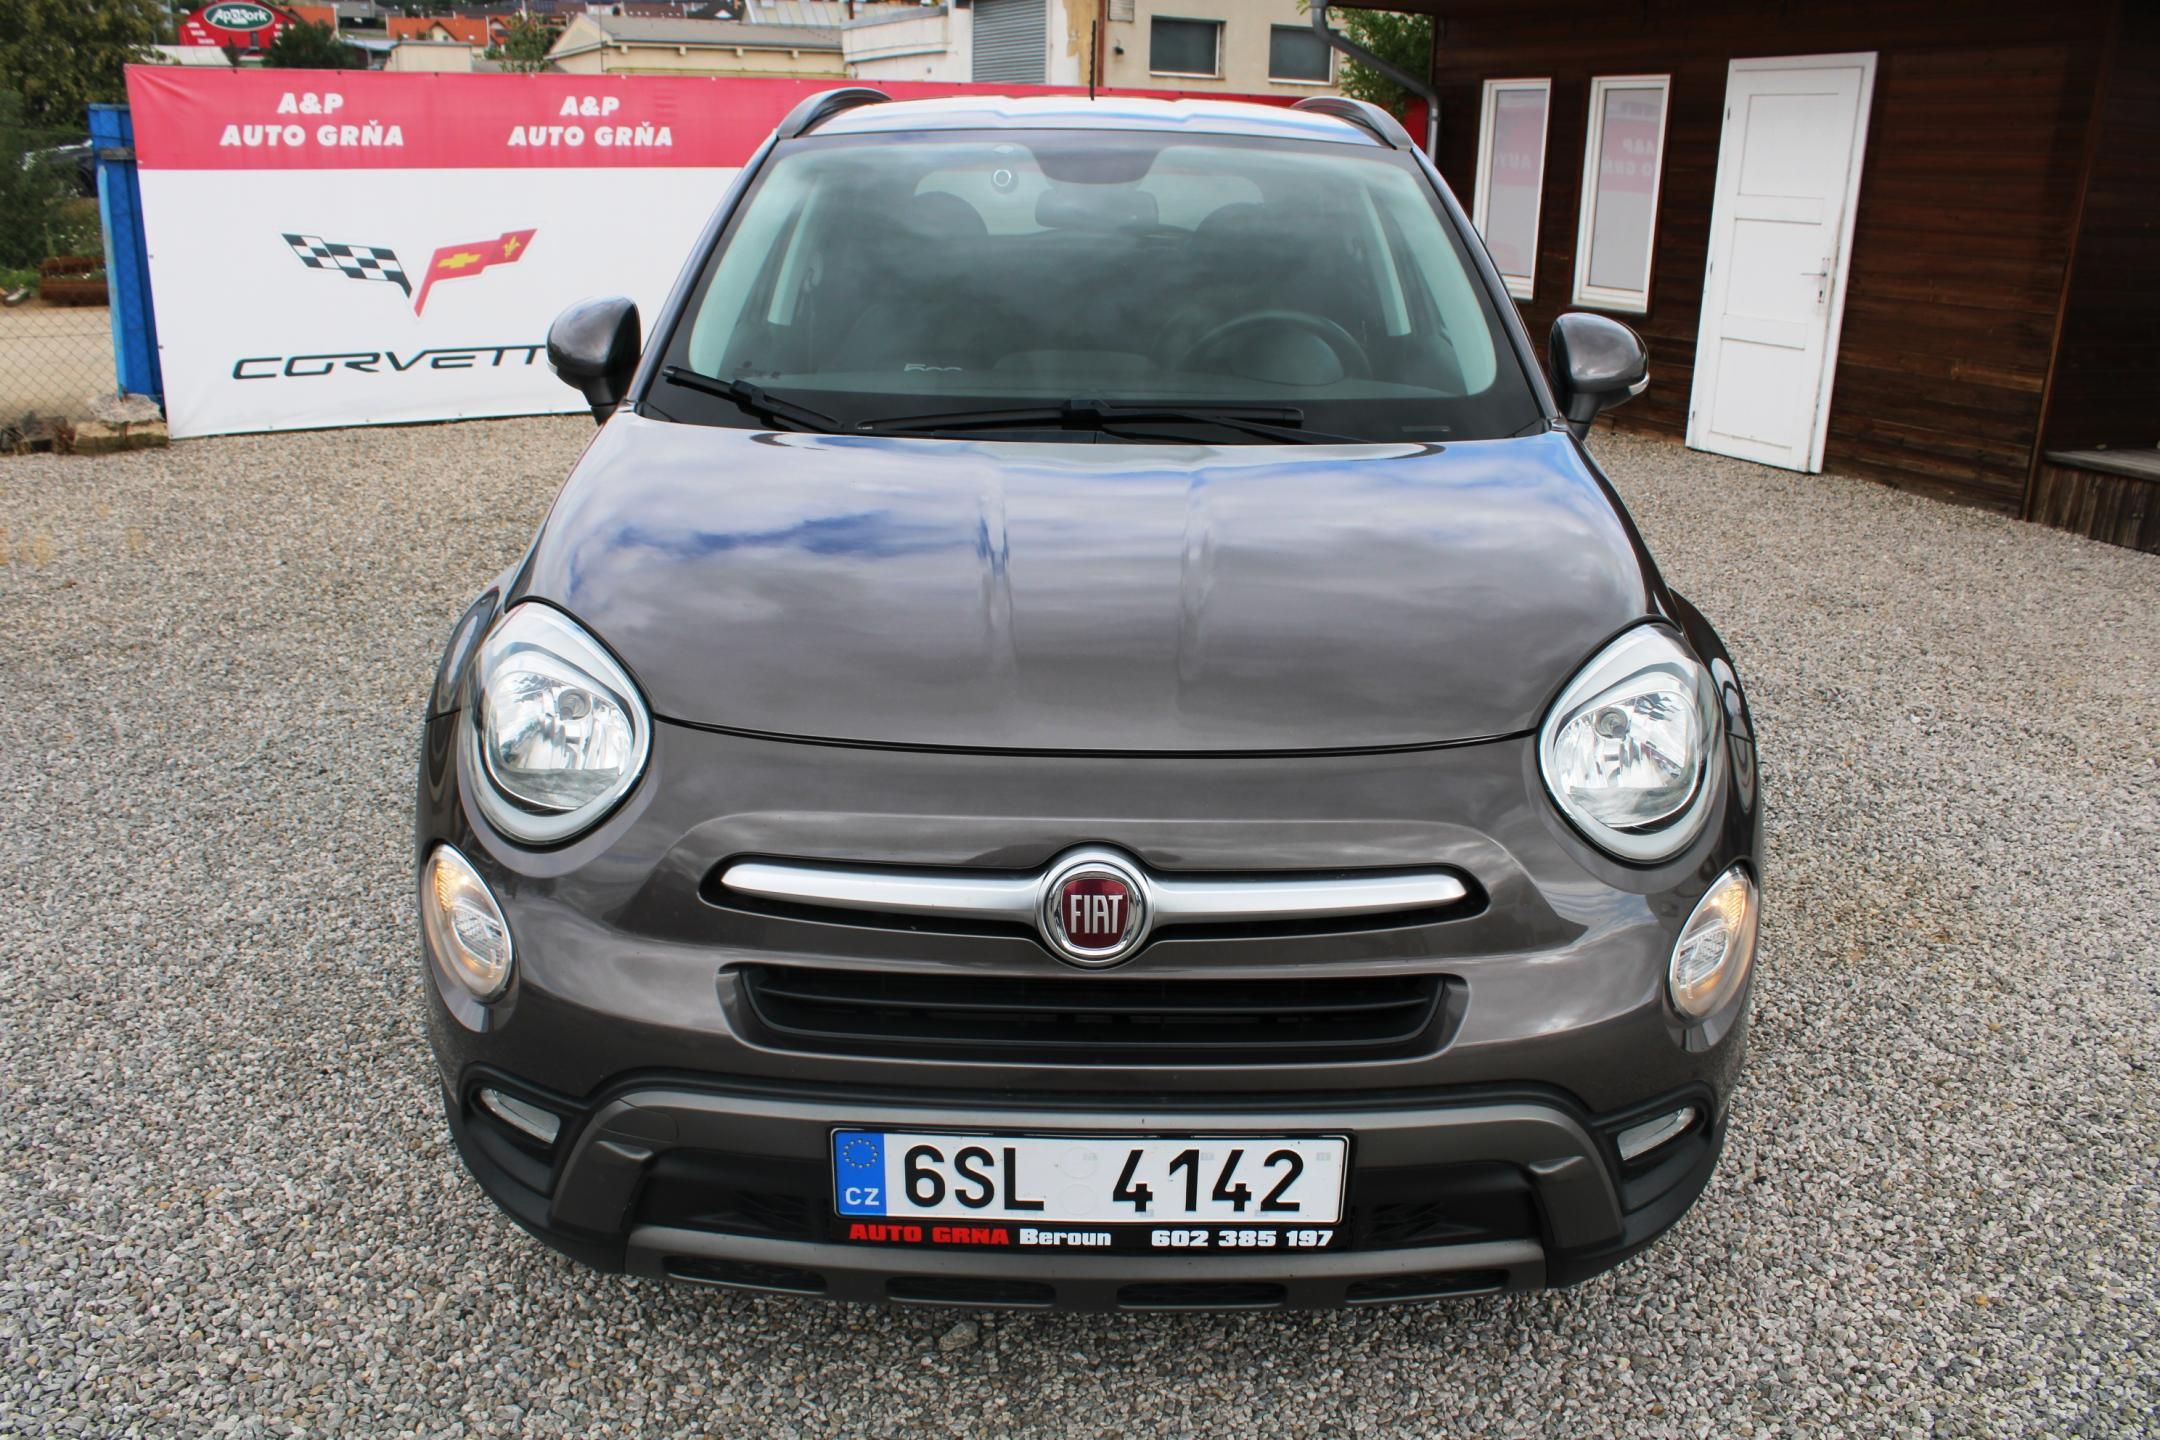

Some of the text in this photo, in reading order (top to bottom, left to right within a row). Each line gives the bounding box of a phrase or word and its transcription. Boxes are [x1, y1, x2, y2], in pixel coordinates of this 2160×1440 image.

[277, 92, 344, 114] A&P
[559, 96, 620, 116] A&P
[219, 119, 404, 146] AUTO GRŇA
[507, 121, 673, 146] AUTO GRŇA
[232, 344, 546, 380] CORVETT
[1070, 894, 1123, 934] FIAT
[904, 1144, 1304, 1212] 6SL 4142
[845, 1187, 880, 1206] CZ
[849, 1223, 922, 1243] AUTO
[1019, 1228, 1112, 1246] Beroun
[1151, 1230, 1209, 1247] 602
[1218, 1230, 1276, 1247] 385
[1286, 1230, 1334, 1247] 197
